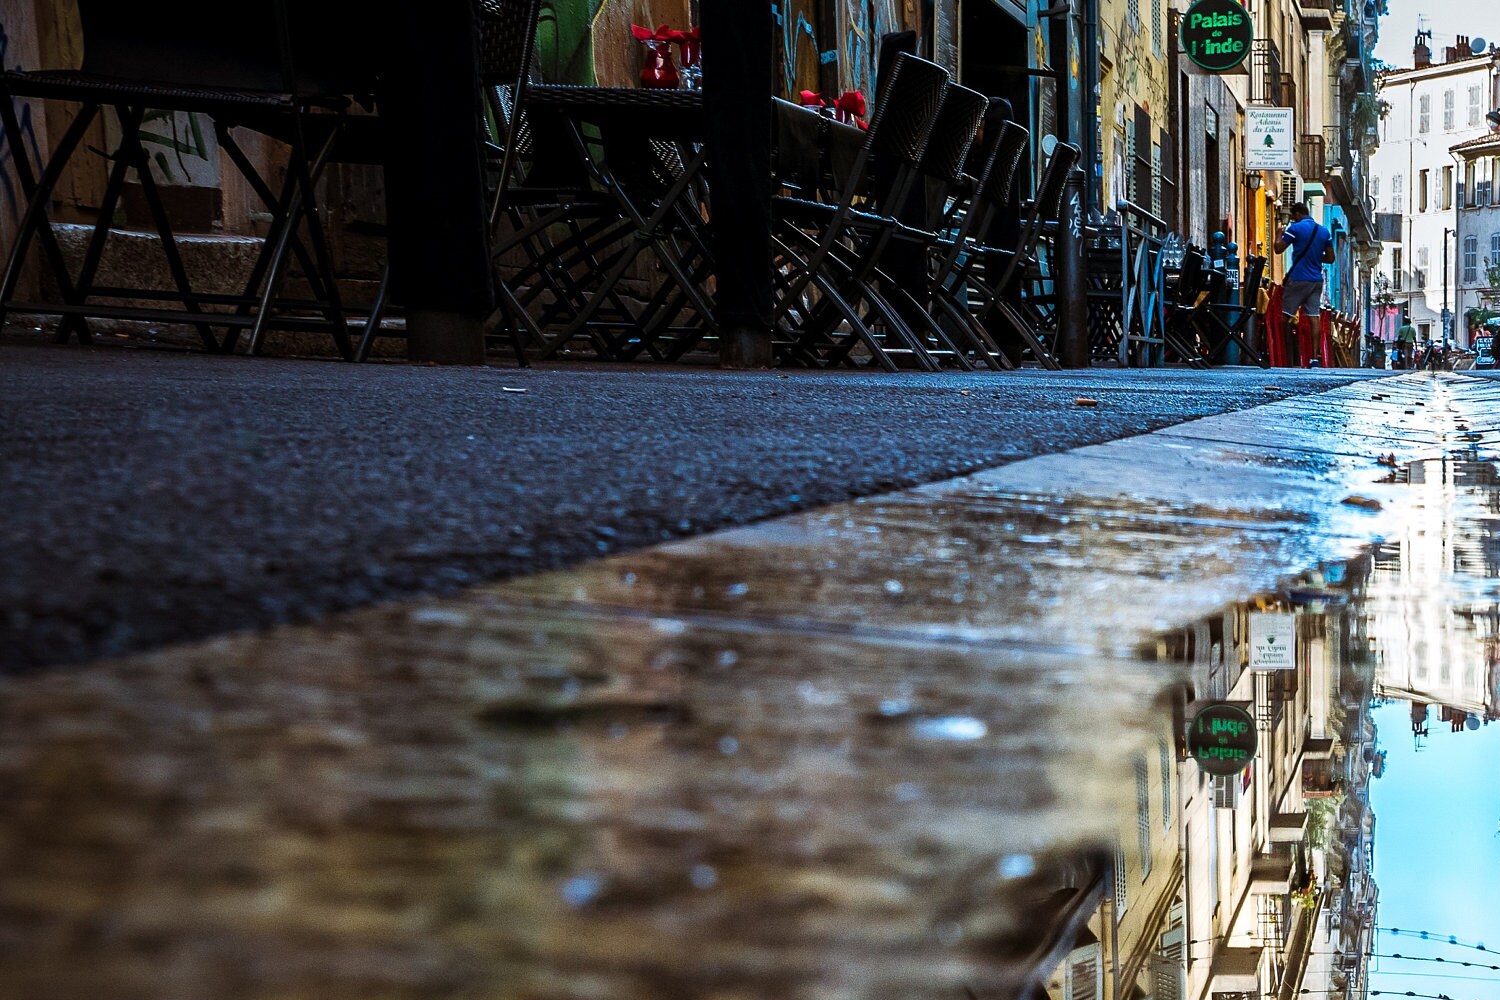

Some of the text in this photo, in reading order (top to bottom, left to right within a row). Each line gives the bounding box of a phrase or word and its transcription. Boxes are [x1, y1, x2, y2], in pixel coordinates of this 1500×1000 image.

[1190, 11, 1243, 29] Palais
[1211, 29, 1223, 37] de
[1249, 111, 1288, 119] Restaurant
[1252, 125, 1285, 133] du Liban
